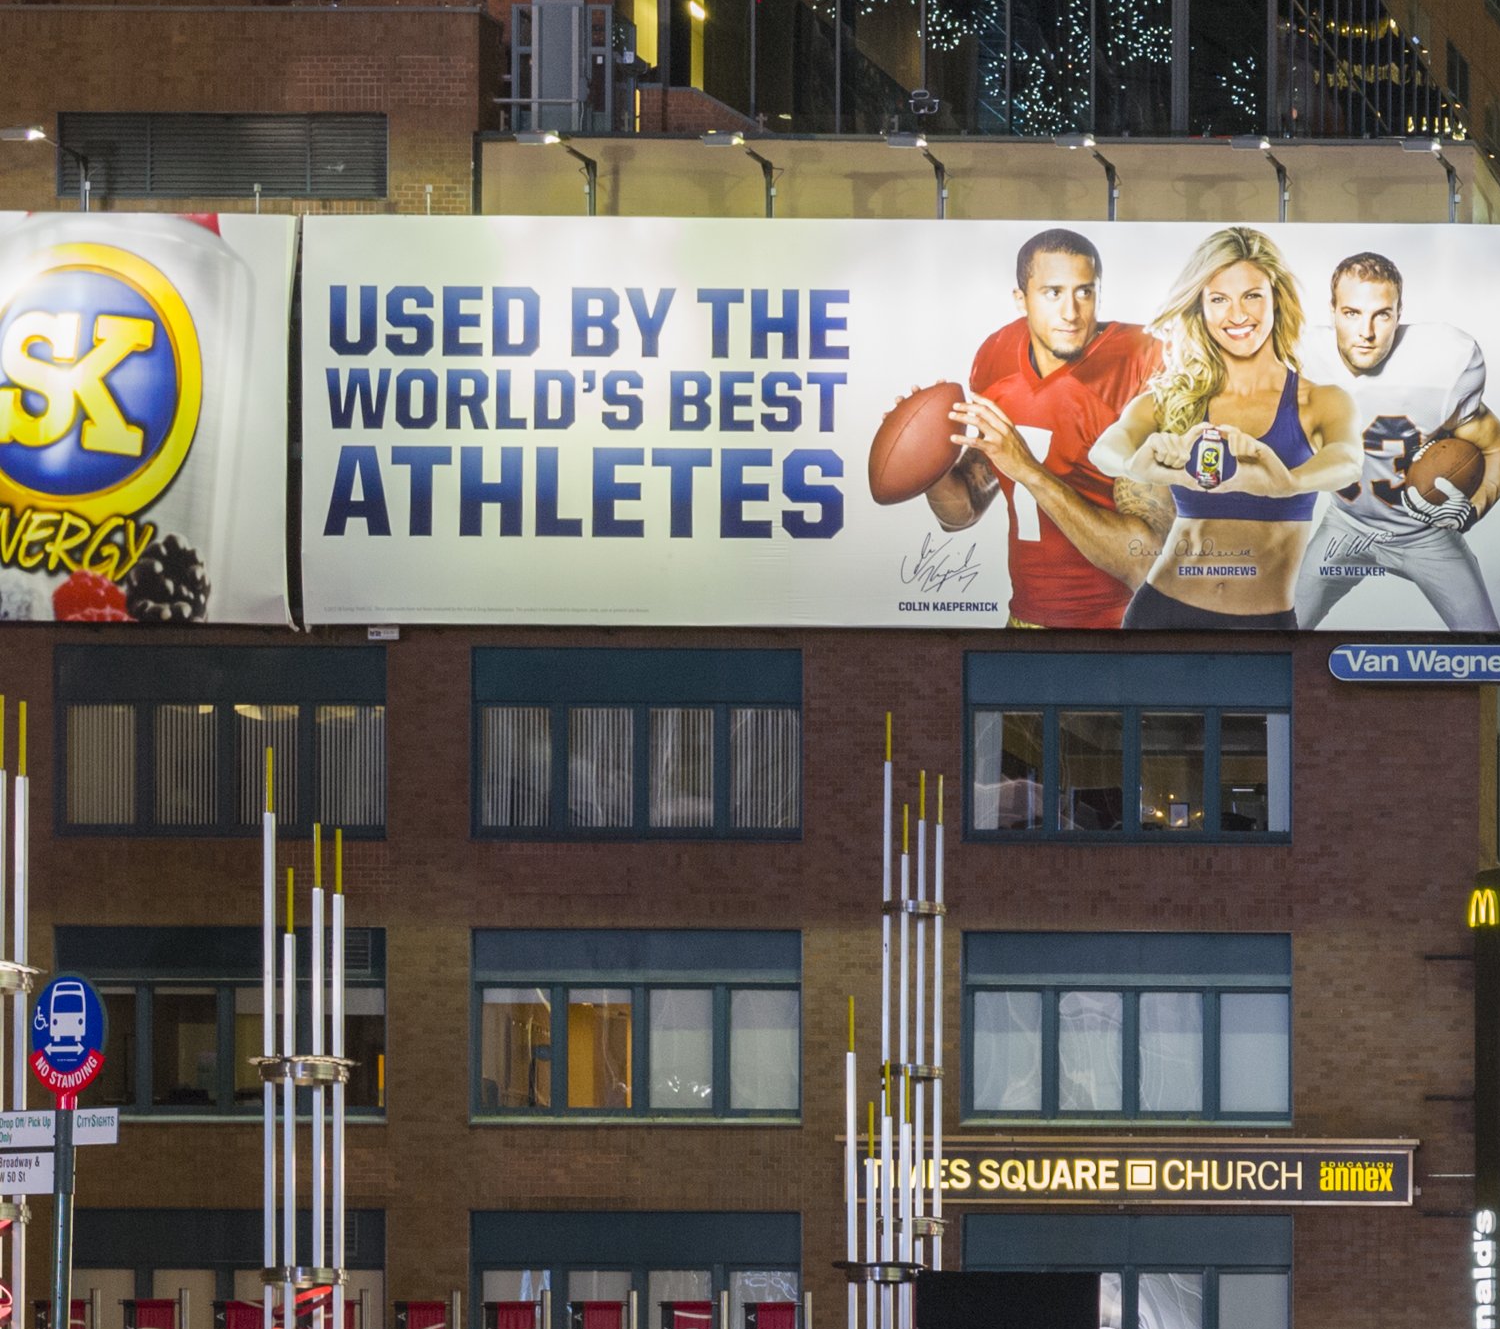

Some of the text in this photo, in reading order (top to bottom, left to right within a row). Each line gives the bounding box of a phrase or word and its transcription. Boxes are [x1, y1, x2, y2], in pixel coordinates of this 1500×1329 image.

[329, 285, 851, 359] USED BY THE
[325, 367, 848, 433] WORLD'S BEST
[323, 445, 845, 540] ATHLETES
[1178, 565, 1257, 577] ERIN ANDREWS
[1319, 566, 1386, 577] WES WELKER
[898, 601, 999, 613] COLIN KAEPERNICK
[1340, 649, 1401, 675] Van
[35, 1057, 98, 1088] NO STANDING
[7, 1171, 26, 1183] 50 St
[978, 1158, 1303, 1196] SQUARE CHURCH
[1320, 1161, 1394, 1169] EDUCATION
[1319, 1166, 1394, 1193] annex
